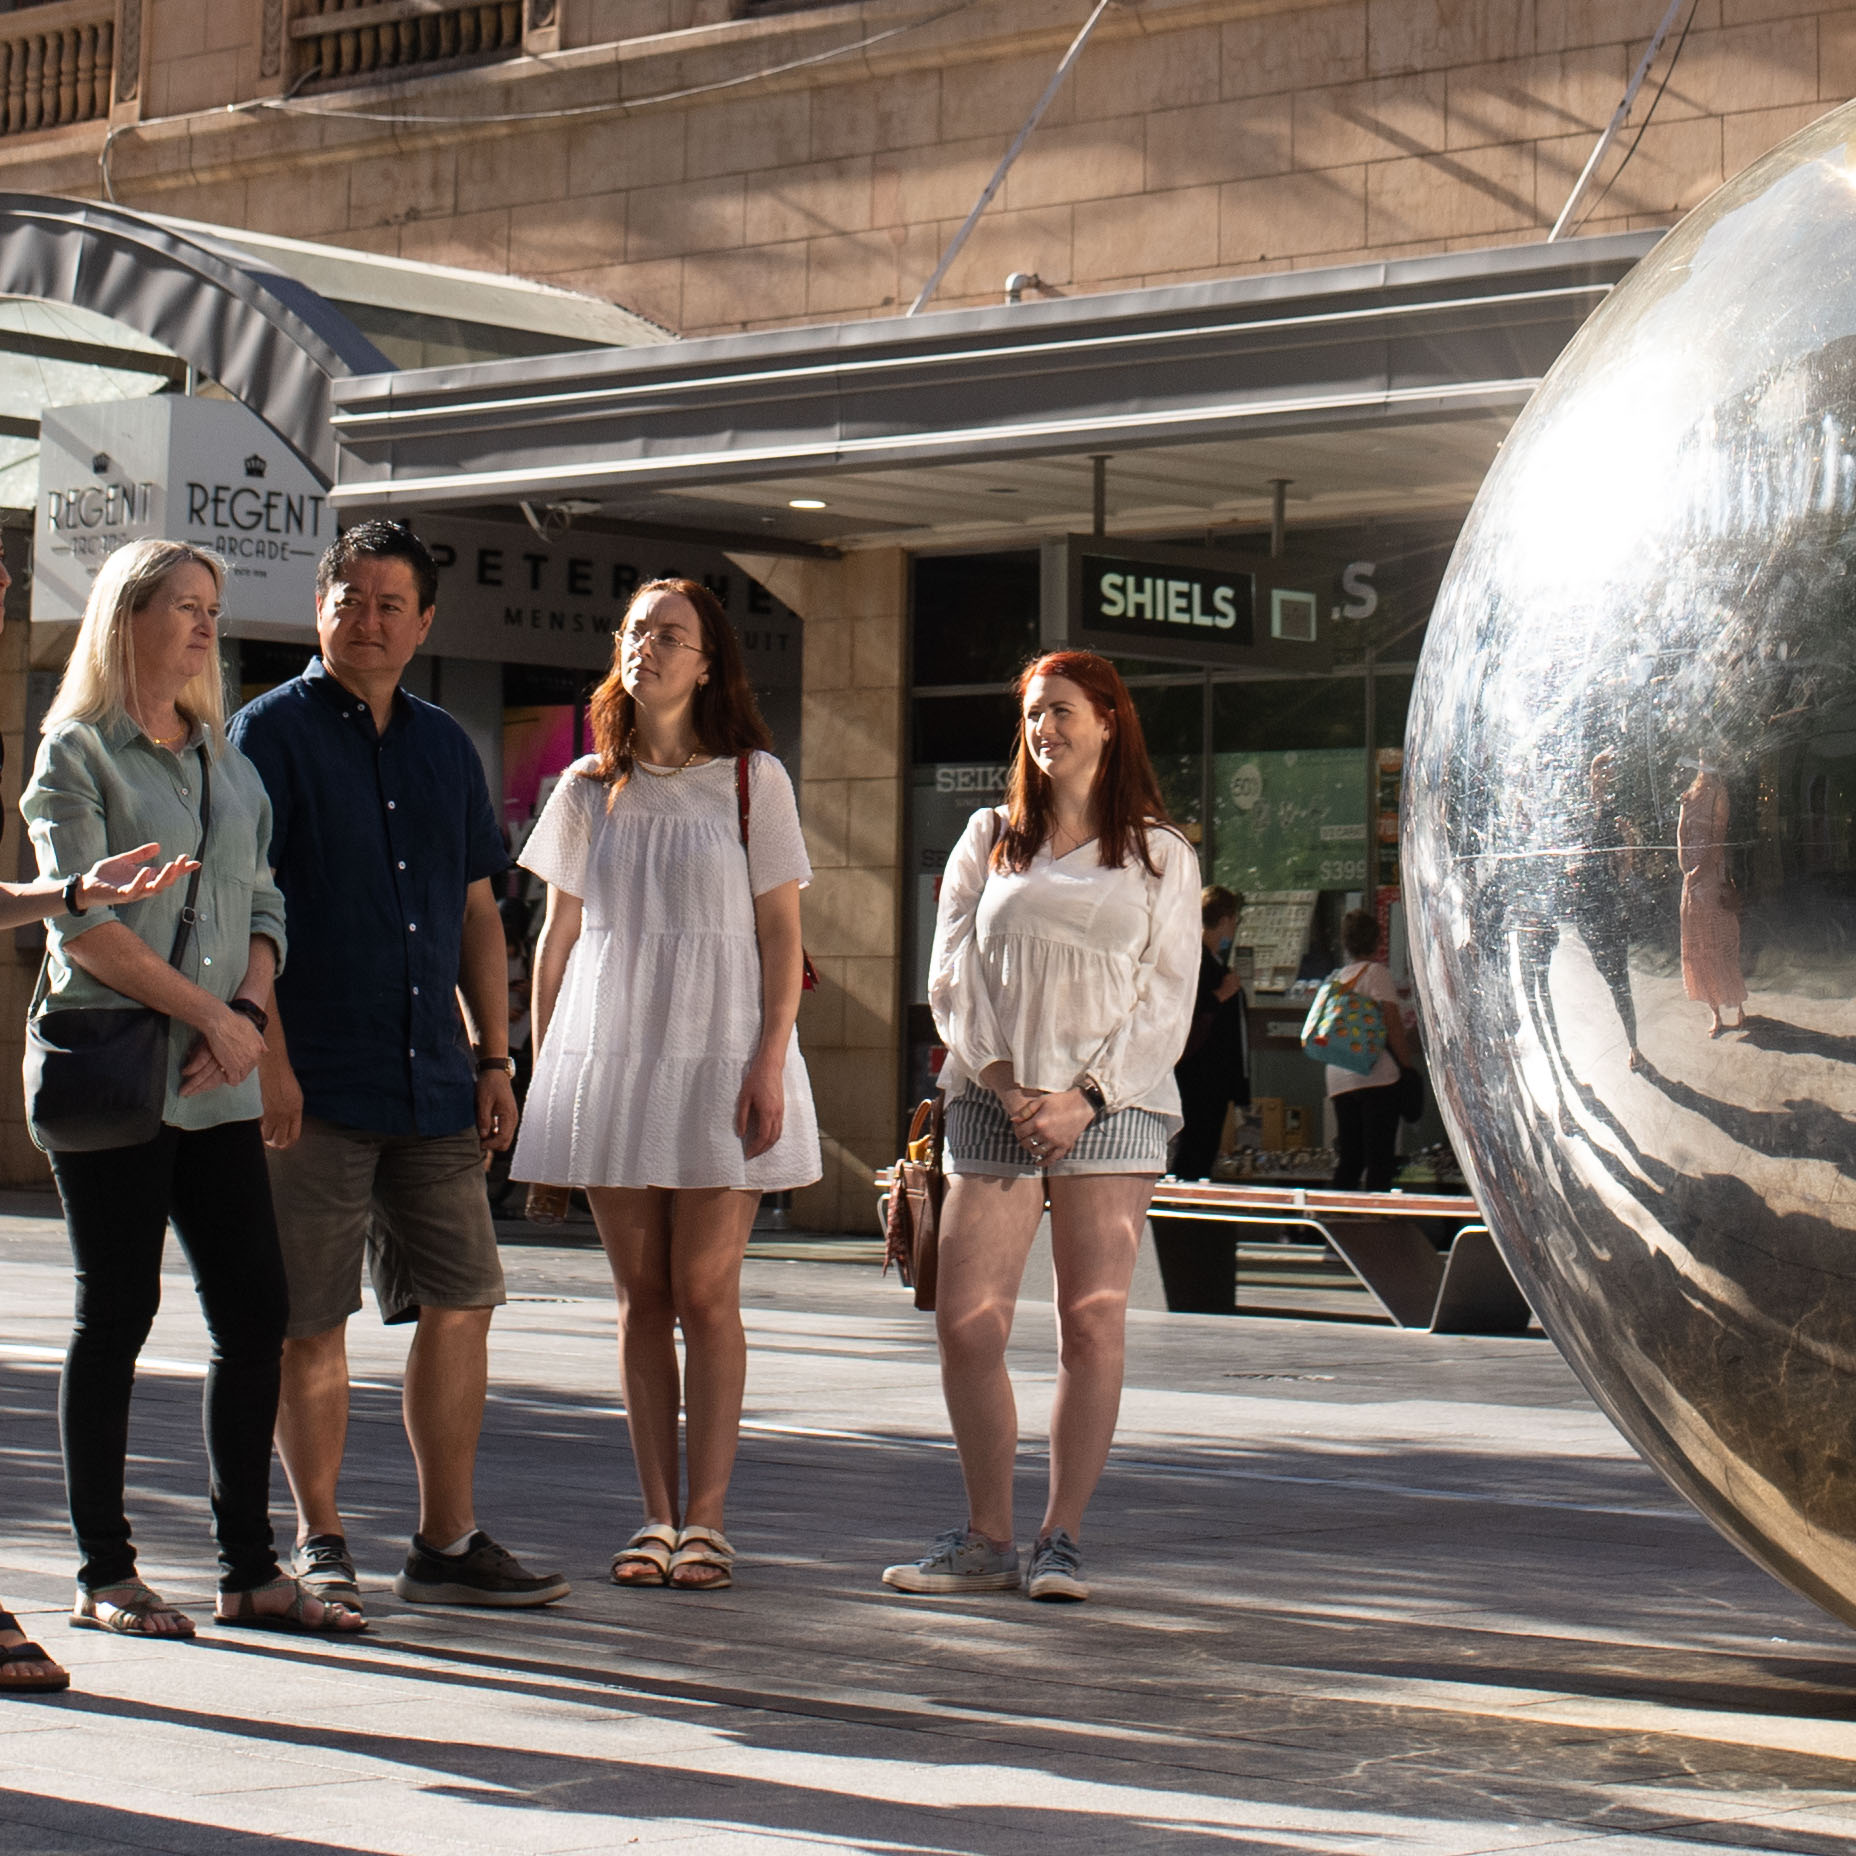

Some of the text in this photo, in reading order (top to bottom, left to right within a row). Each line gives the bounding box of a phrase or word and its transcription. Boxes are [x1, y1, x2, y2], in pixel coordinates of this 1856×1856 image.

[47, 482, 153, 534] REGENT
[186, 482, 326, 538] REGENT
[215, 535, 289, 561] ARCADE
[1100, 572, 1238, 630] SHIELS
[504, 606, 611, 634] MENSW
[745, 631, 790, 651] UIT
[935, 766, 1007, 793] SEIK
